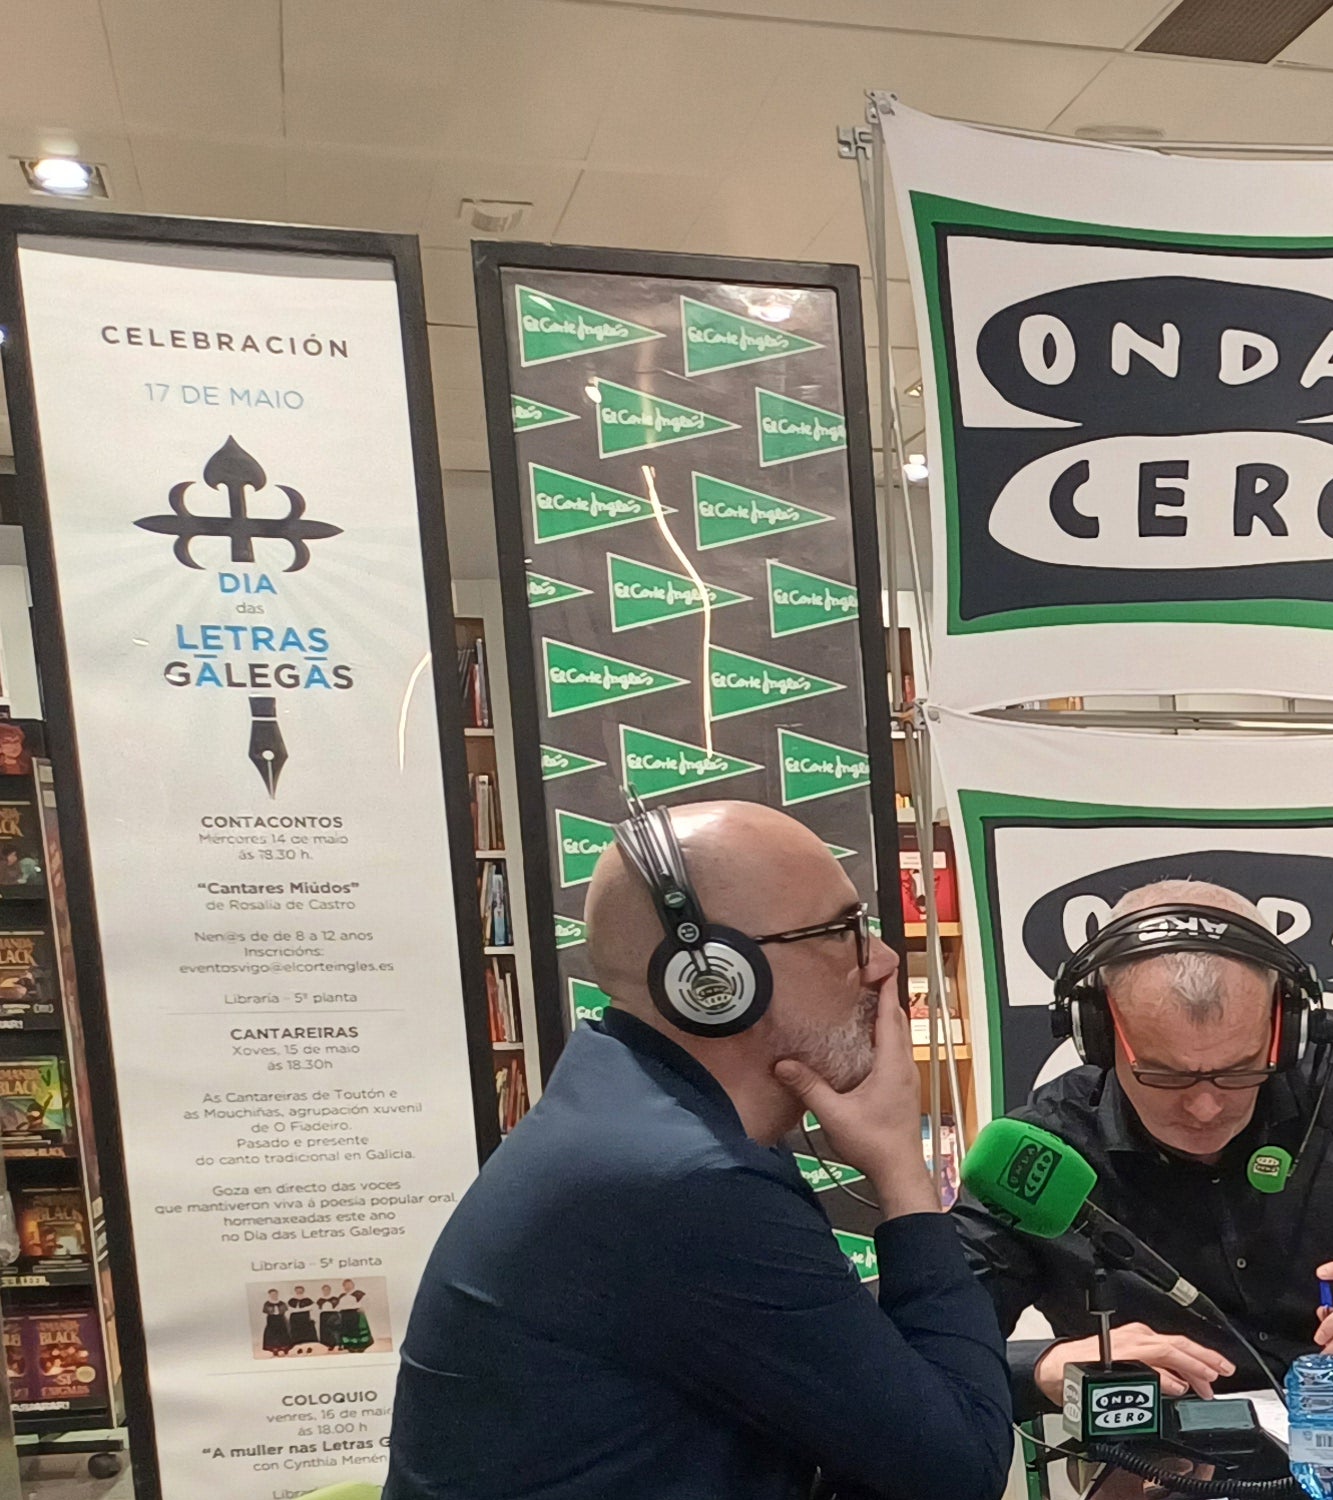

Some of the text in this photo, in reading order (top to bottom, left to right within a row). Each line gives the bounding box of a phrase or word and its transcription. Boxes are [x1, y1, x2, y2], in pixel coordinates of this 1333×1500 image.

[101, 325, 348, 358] CELEBRACIÓN
[145, 383, 304, 410] 17 DE MAIO
[235, 602, 265, 614] das
[175, 624, 330, 653] LETRAS
[201, 816, 343, 828] CONTACONTOS
[290, 833, 309, 844] de
[313, 834, 348, 844] maio
[206, 900, 225, 911] de
[286, 899, 304, 910] de
[309, 899, 355, 910] Castro
[250, 931, 268, 942] de
[273, 931, 291, 942] de
[296, 931, 305, 942] 8
[340, 932, 374, 941] anos
[313, 992, 357, 1005] planta
[230, 1026, 358, 1040] CANTAREIRAS
[303, 1044, 321, 1055] de
[325, 1044, 360, 1054] maio
[203, 1093, 221, 1103] As
[225, 1091, 307, 1103] Cantareiras
[312, 1089, 330, 1100] de
[251, 1123, 269, 1133] de
[237, 1138, 289, 1149] Pasado
[307, 1136, 369, 1148] presente
[196, 1156, 214, 1166] do
[219, 1155, 260, 1165] canto
[264, 1152, 340, 1164] tradicional
[344, 1152, 362, 1161] en
[212, 1180, 401, 1197] Goza en directo das voces
[155, 1204, 182, 1216] que
[187, 1199, 269, 1213] mantiveron
[274, 1198, 303, 1209] viva
[370, 1194, 423, 1208] popular
[223, 1211, 396, 1227] homenaxeadas este ano
[221, 1232, 239, 1242] no
[272, 1229, 297, 1240] das
[301, 1226, 345, 1239] Letras
[349, 1224, 406, 1238] Galegas
[338, 1255, 383, 1269] planta
[282, 1390, 378, 1407] COLOQUIO
[1100, 1394, 1145, 1407] ONDA
[339, 1408, 357, 1418] de
[1103, 1412, 1145, 1423] CERO
[230, 1444, 283, 1457] muller
[289, 1443, 317, 1454] nas
[323, 1439, 373, 1452] Letras
[253, 1454, 386, 1472] con Cynthia Menén
